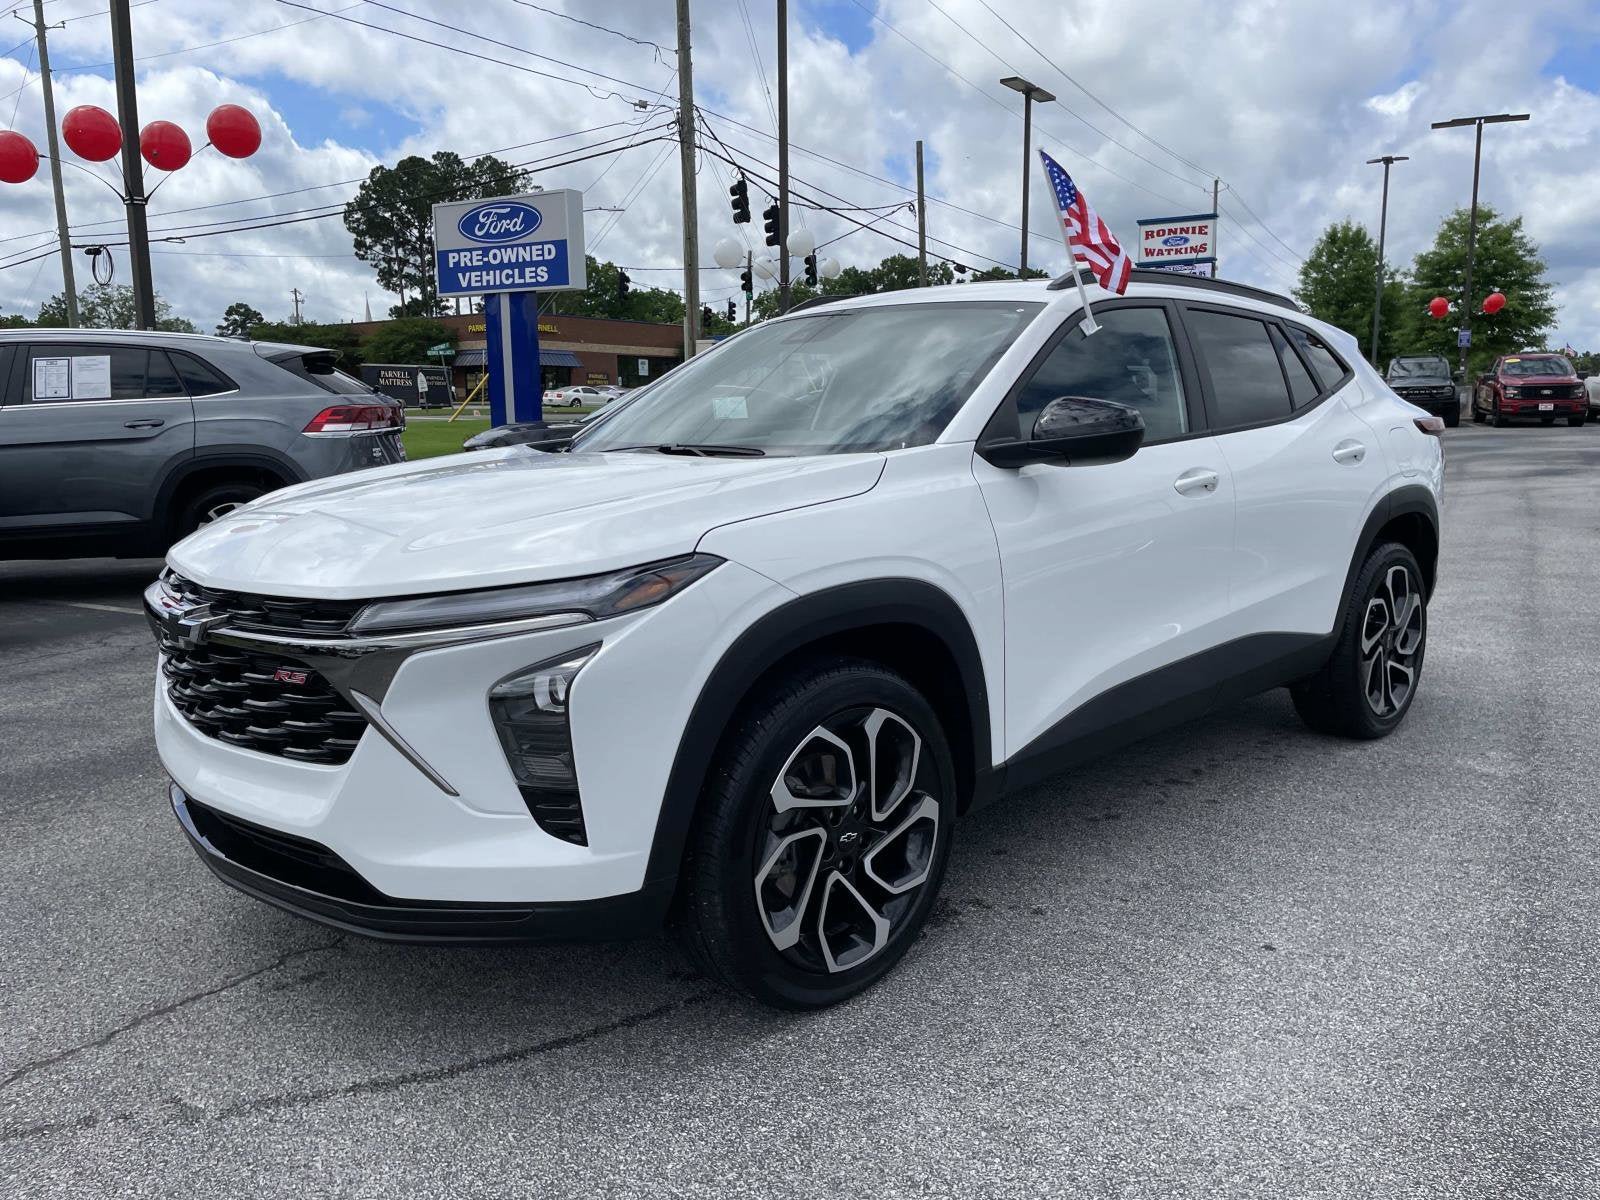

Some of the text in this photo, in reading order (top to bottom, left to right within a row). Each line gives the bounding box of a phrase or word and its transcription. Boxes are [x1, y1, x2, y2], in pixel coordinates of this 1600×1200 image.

[474, 206, 525, 237] Ford
[1144, 225, 1208, 240] RONNIE
[1166, 237, 1185, 247] Ford
[448, 244, 557, 268] PRE-OWNED
[1144, 242, 1208, 257] WATKINS
[457, 266, 549, 287] VEHICLES
[537, 324, 559, 333] RNELL
[380, 370, 410, 379] PARNELL
[379, 378, 413, 386] MATTRESS
[274, 670, 306, 684] RS
